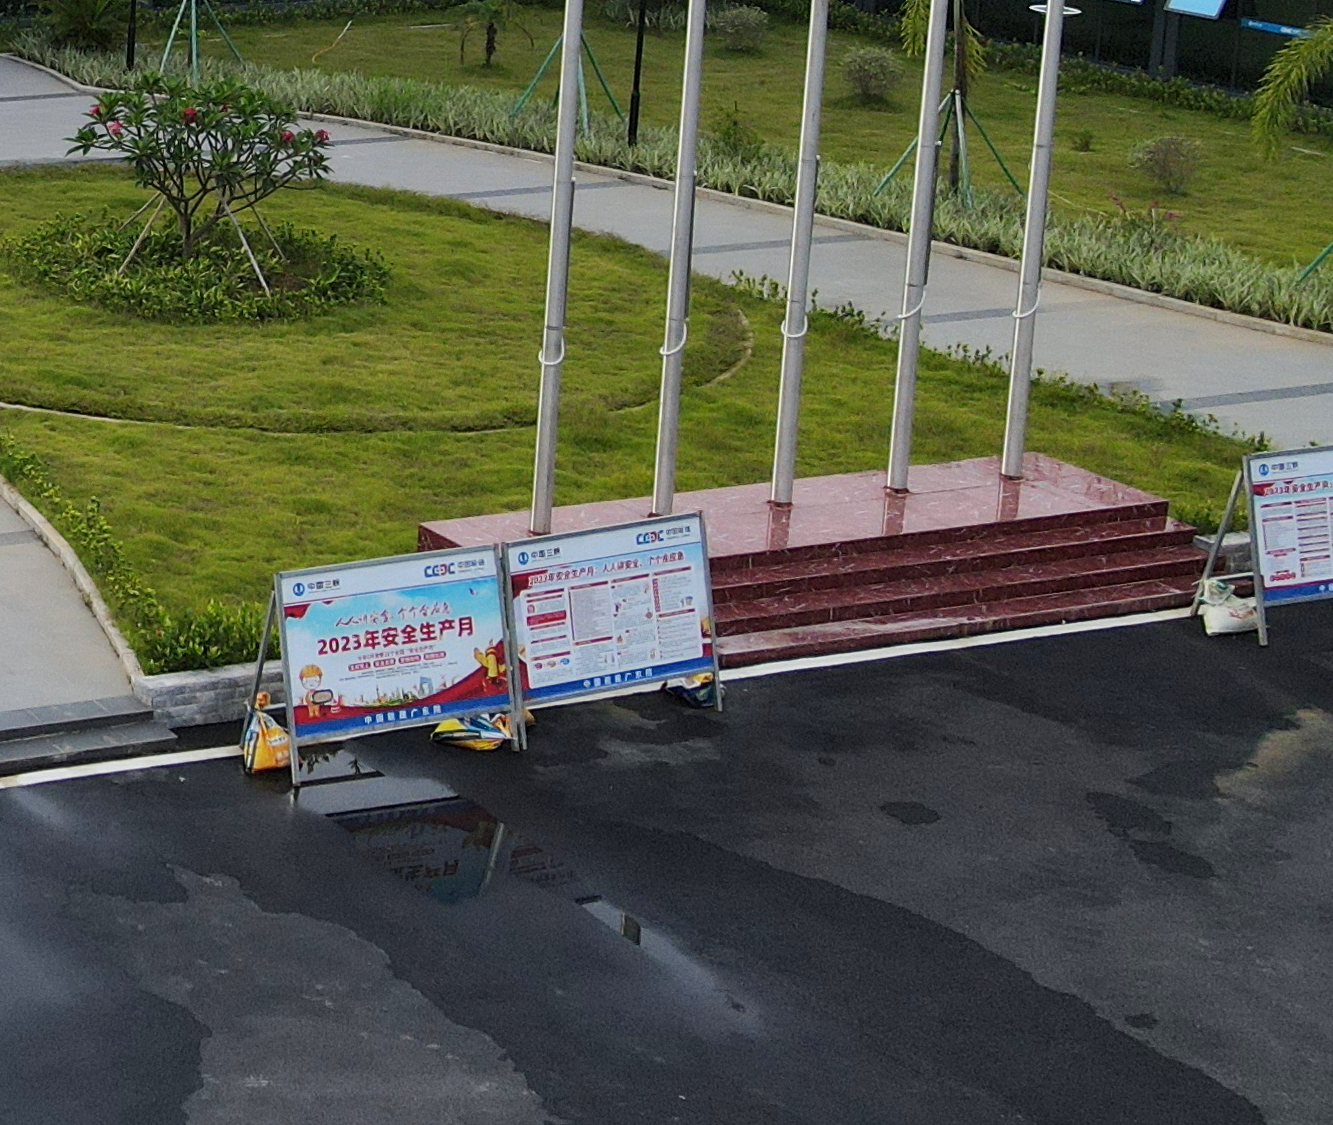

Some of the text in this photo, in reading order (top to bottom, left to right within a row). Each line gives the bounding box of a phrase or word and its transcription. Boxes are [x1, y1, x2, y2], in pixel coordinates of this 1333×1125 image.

[530, 547, 562, 559] 中国三峡
[307, 579, 341, 591] 中国三峡
[316, 615, 475, 655] 2023年安全生产月
